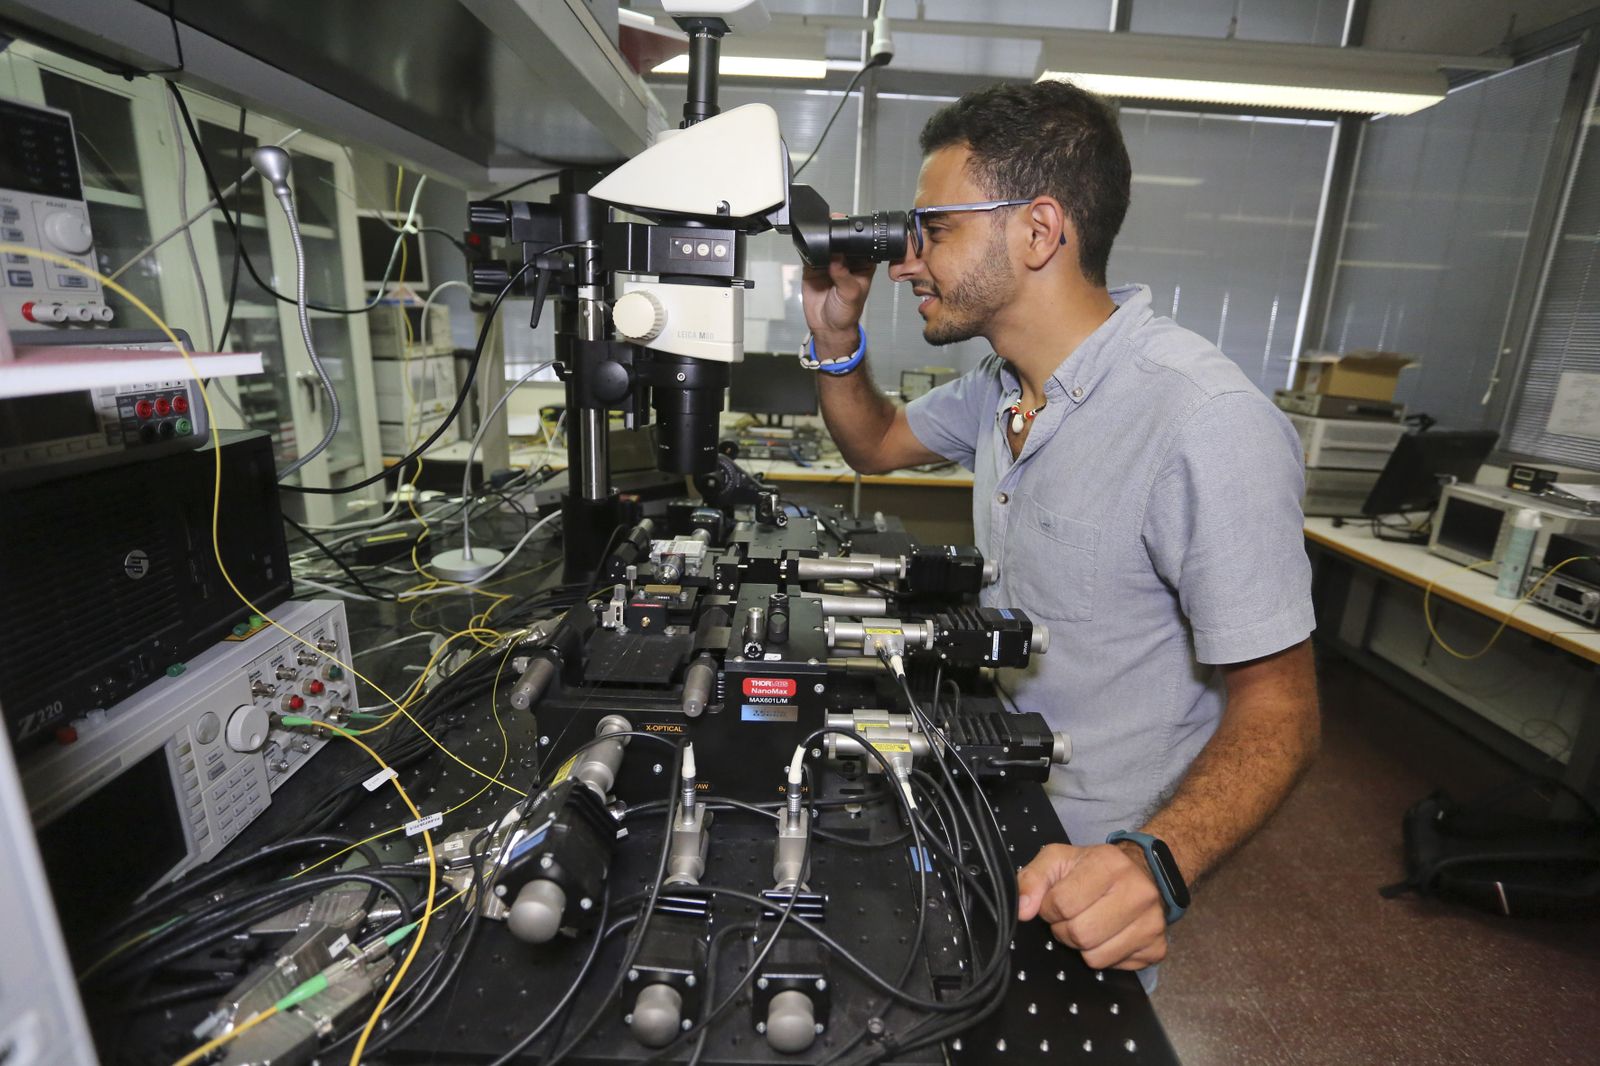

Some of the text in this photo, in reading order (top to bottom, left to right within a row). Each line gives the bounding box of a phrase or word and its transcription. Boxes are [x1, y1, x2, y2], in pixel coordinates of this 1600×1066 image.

[750, 679, 789, 687] THORLABS
[751, 687, 788, 695] NanoMax
[17, 701, 63, 742] Z220
[646, 724, 683, 732] X-OPTICAL
